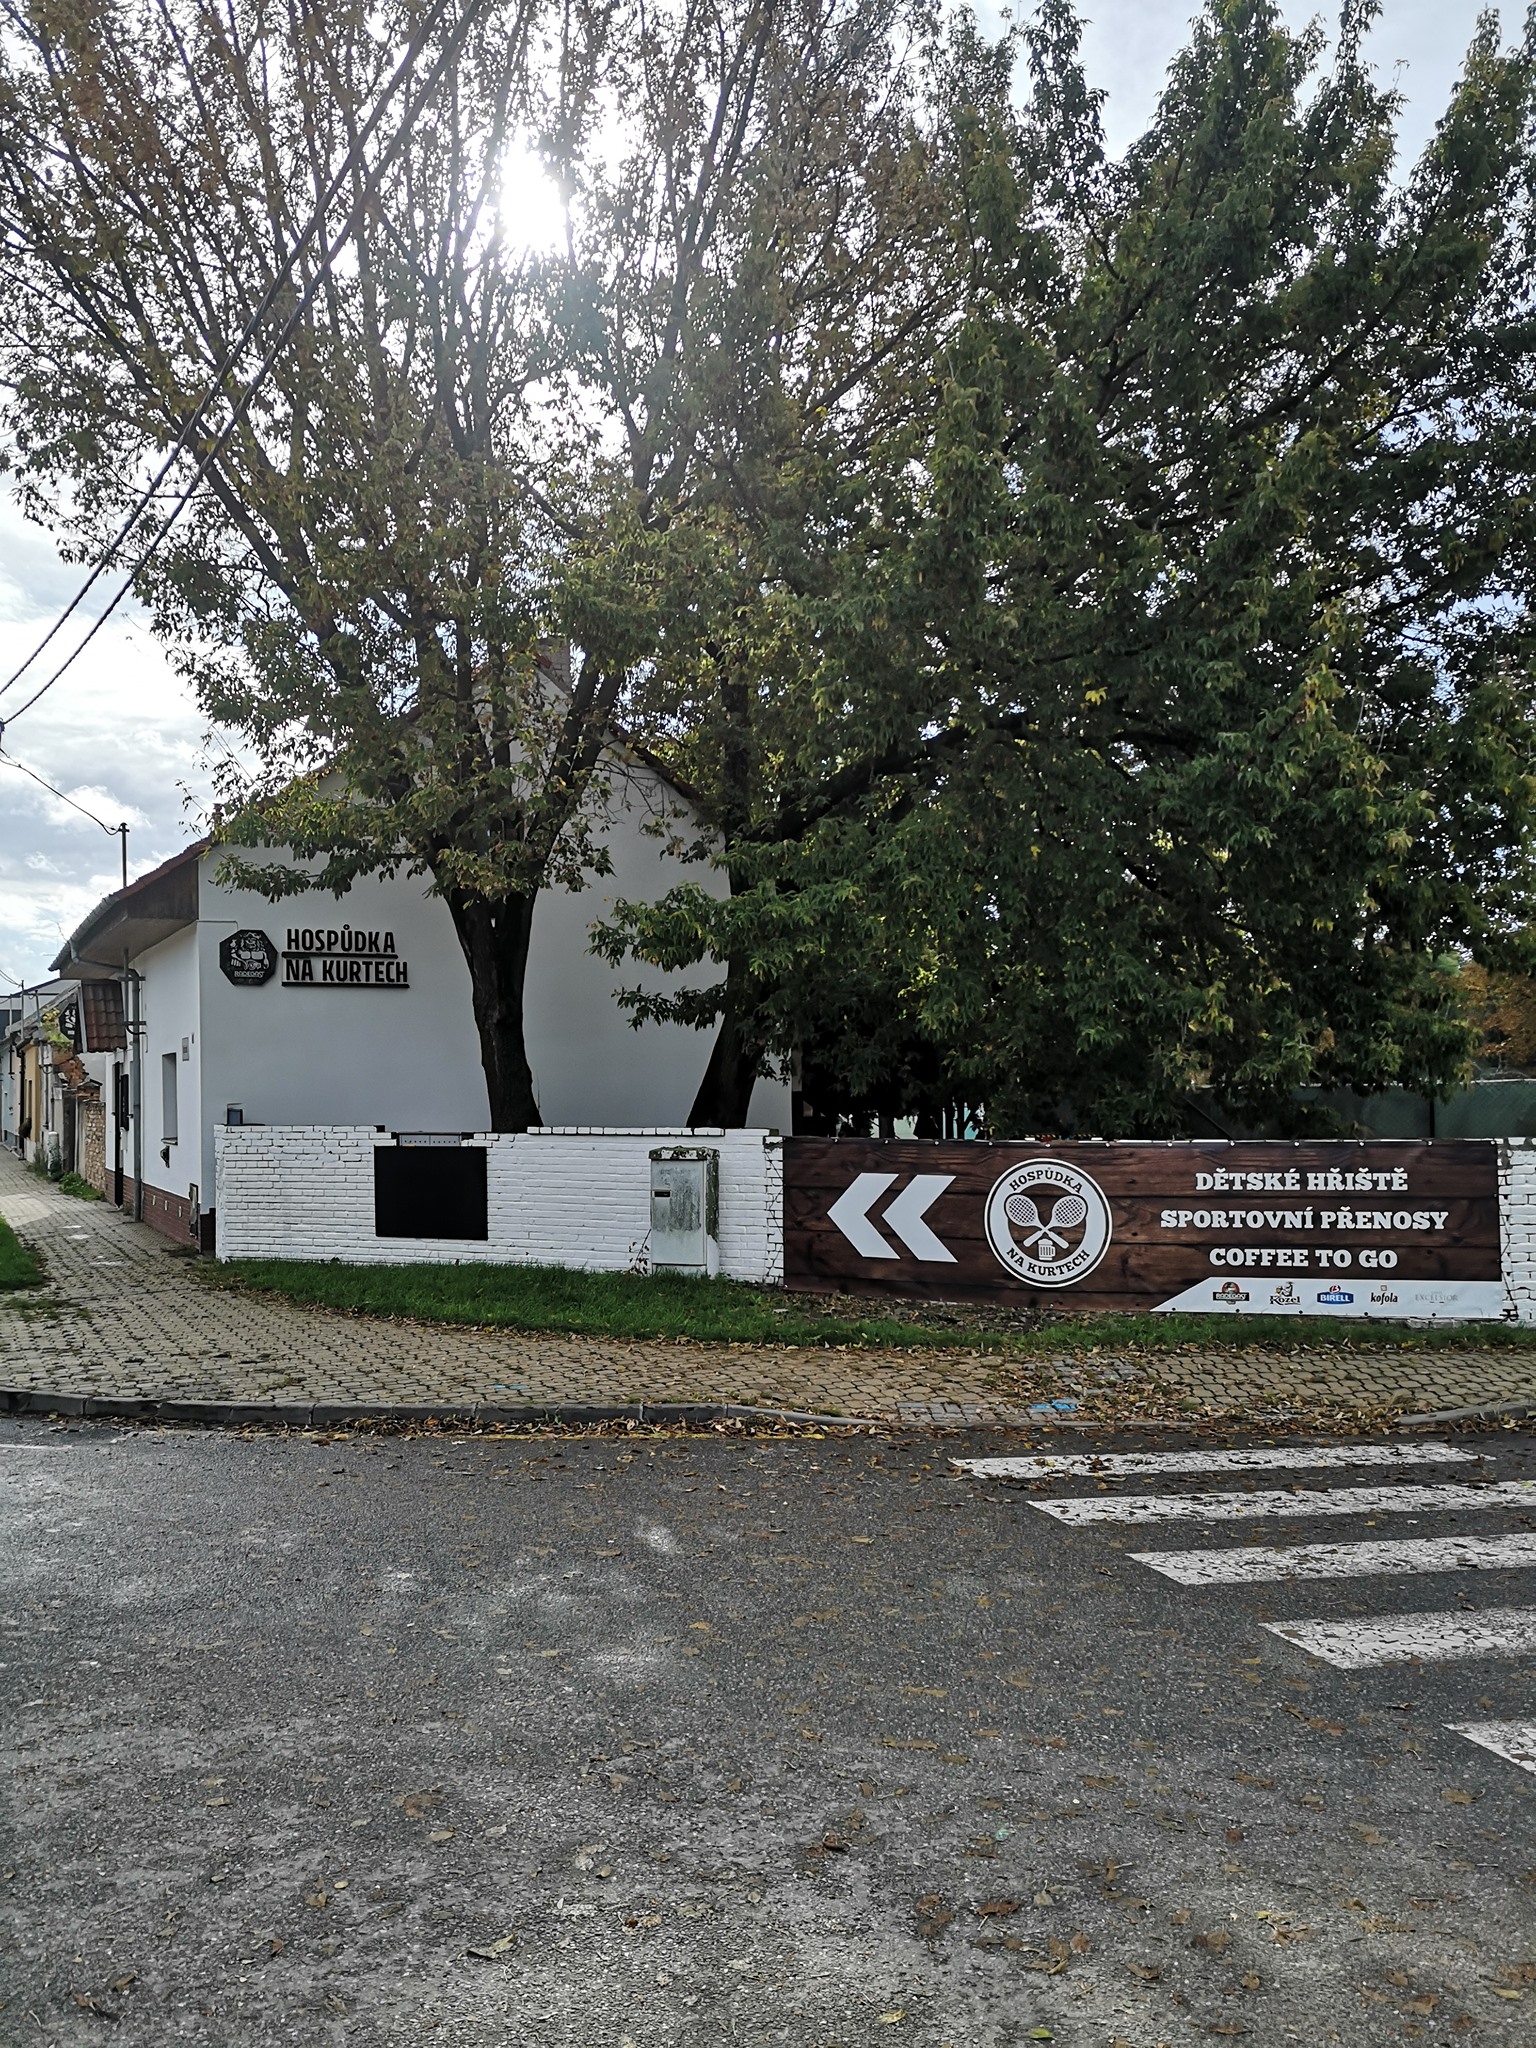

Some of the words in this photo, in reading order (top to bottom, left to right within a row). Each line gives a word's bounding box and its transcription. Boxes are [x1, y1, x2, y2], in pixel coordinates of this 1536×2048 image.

[287, 924, 396, 953] HOSPŮDKA
[286, 959, 314, 981] NA
[322, 960, 408, 983] KURTECH
[1009, 1167, 1083, 1193] HOSPŮDKA
[1195, 1167, 1300, 1190] DĚTSKÉ
[1307, 1167, 1408, 1191] HŘIŠTĚ
[1160, 1206, 1314, 1229] SPORTOVNÍ
[1320, 1206, 1449, 1230] PŘENOSY
[1006, 1247, 1025, 1268] NA
[1027, 1249, 1090, 1276] KURTECH
[1209, 1248, 1309, 1267] COFFEE
[1315, 1249, 1353, 1268] TO
[1358, 1249, 1398, 1268] GO
[1270, 1295, 1301, 1305] Kozel
[1320, 1294, 1351, 1302] BIRELL
[1370, 1292, 1398, 1305] kofola
